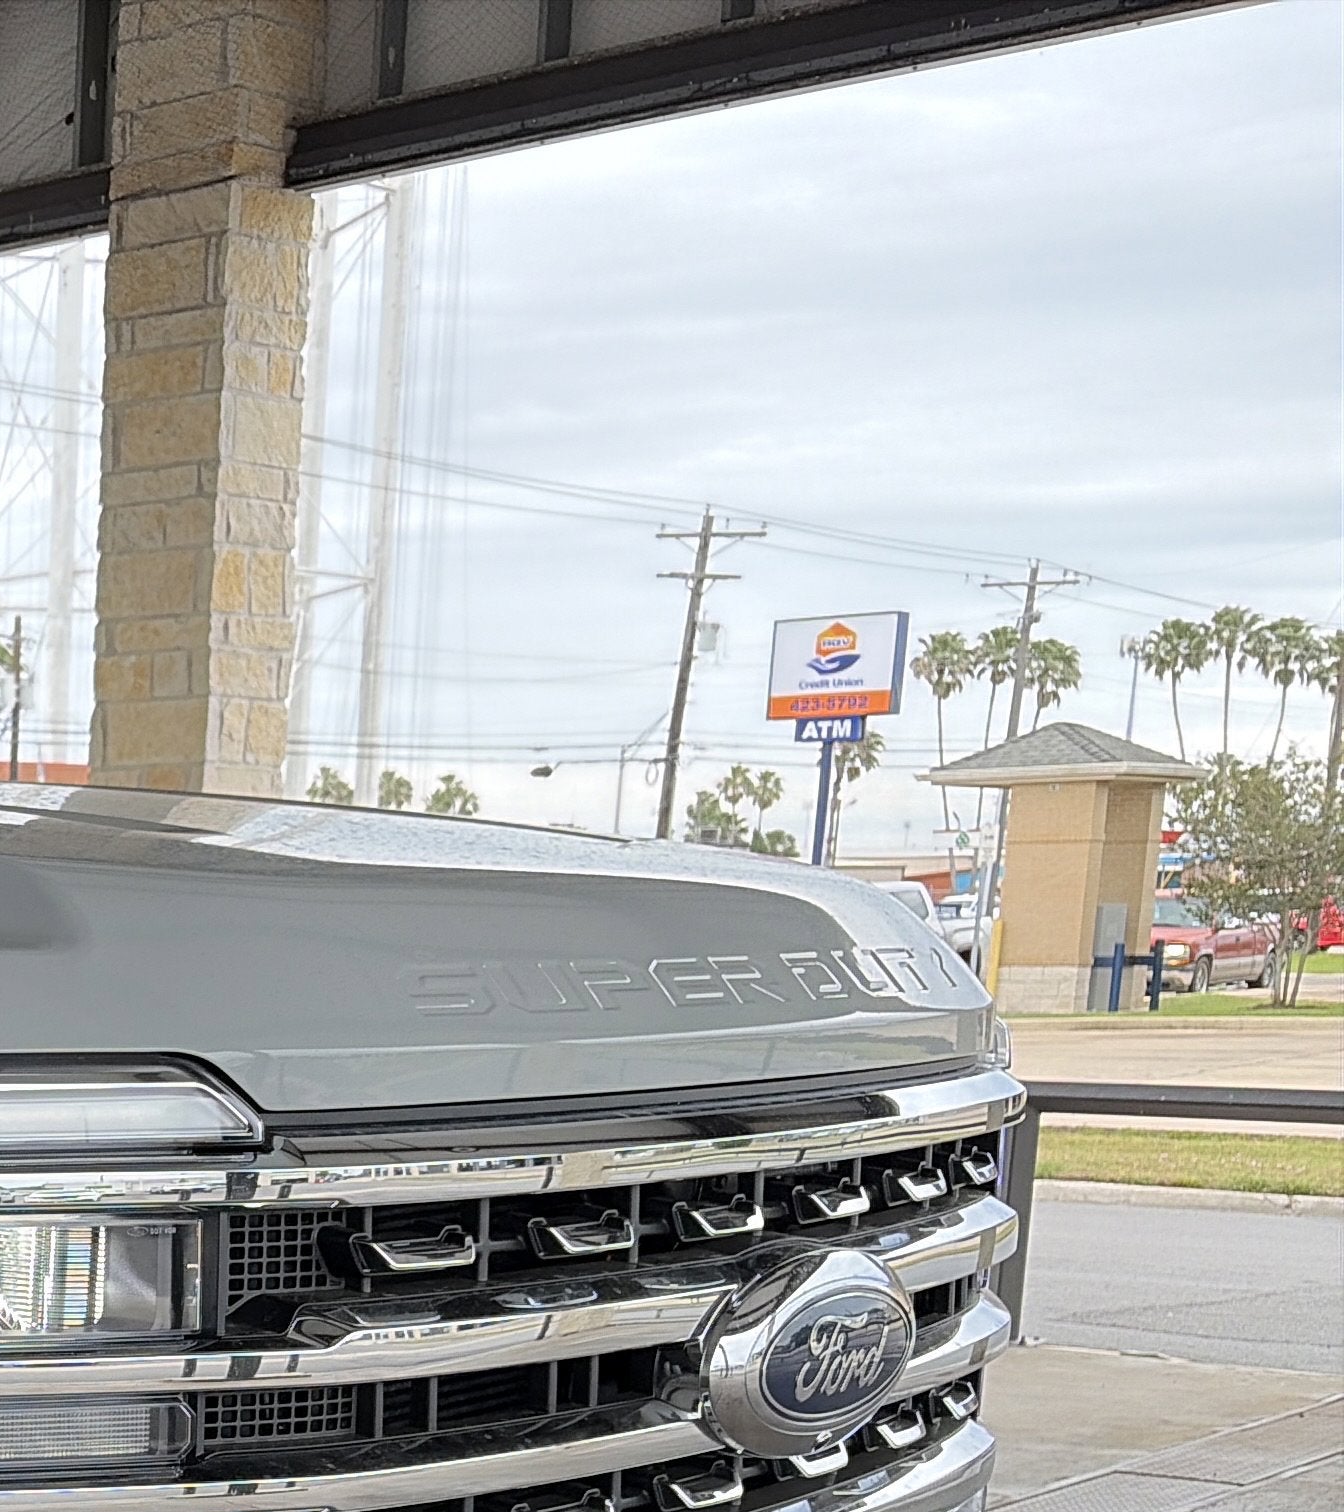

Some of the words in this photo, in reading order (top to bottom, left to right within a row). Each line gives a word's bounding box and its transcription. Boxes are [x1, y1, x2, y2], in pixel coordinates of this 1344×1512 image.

[799, 680, 830, 690] Credit
[833, 678, 864, 687] Union
[801, 719, 852, 739] ATM
[410, 955, 785, 1017] SUPER
[779, 947, 958, 1001] DUTY
[795, 1312, 889, 1403] Ford
